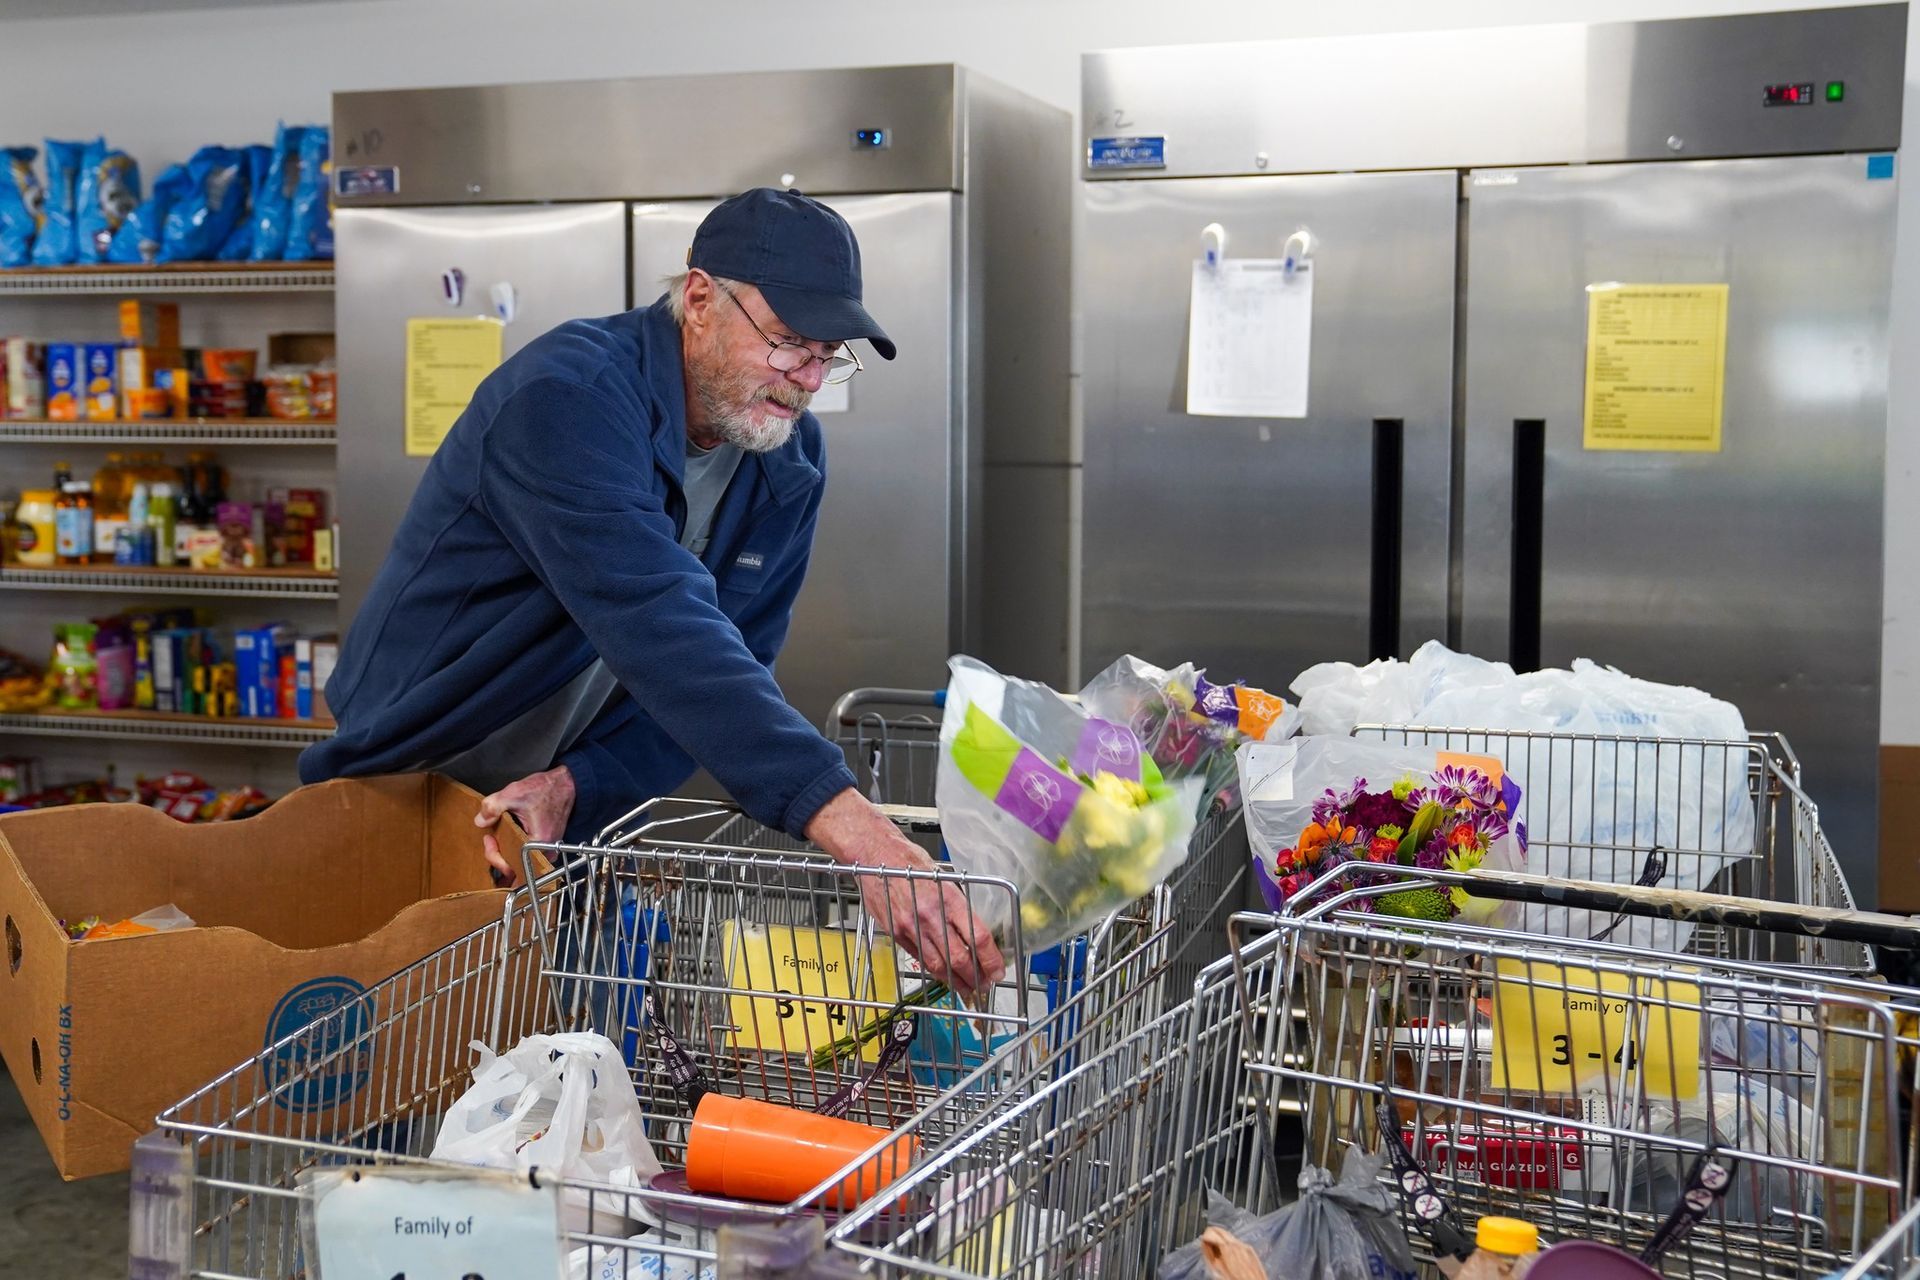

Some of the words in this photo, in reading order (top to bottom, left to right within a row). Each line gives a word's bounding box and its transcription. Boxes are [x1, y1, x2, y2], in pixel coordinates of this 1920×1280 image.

[783, 955, 822, 973] Family
[825, 962, 838, 973] of
[59, 1004, 72, 1029] BX
[776, 990, 794, 1018] 3
[828, 999, 846, 1026] 4
[1562, 998, 1610, 1015] Famiy
[1552, 1034, 1571, 1065] 3
[1613, 1040, 1637, 1070] 4
[1416, 1160, 1484, 1171] OIGNAL
[1490, 1162, 1546, 1173] GLAZED
[1566, 1152, 1578, 1164] 6
[394, 1216, 450, 1239] Family
[455, 1215, 473, 1235] of
